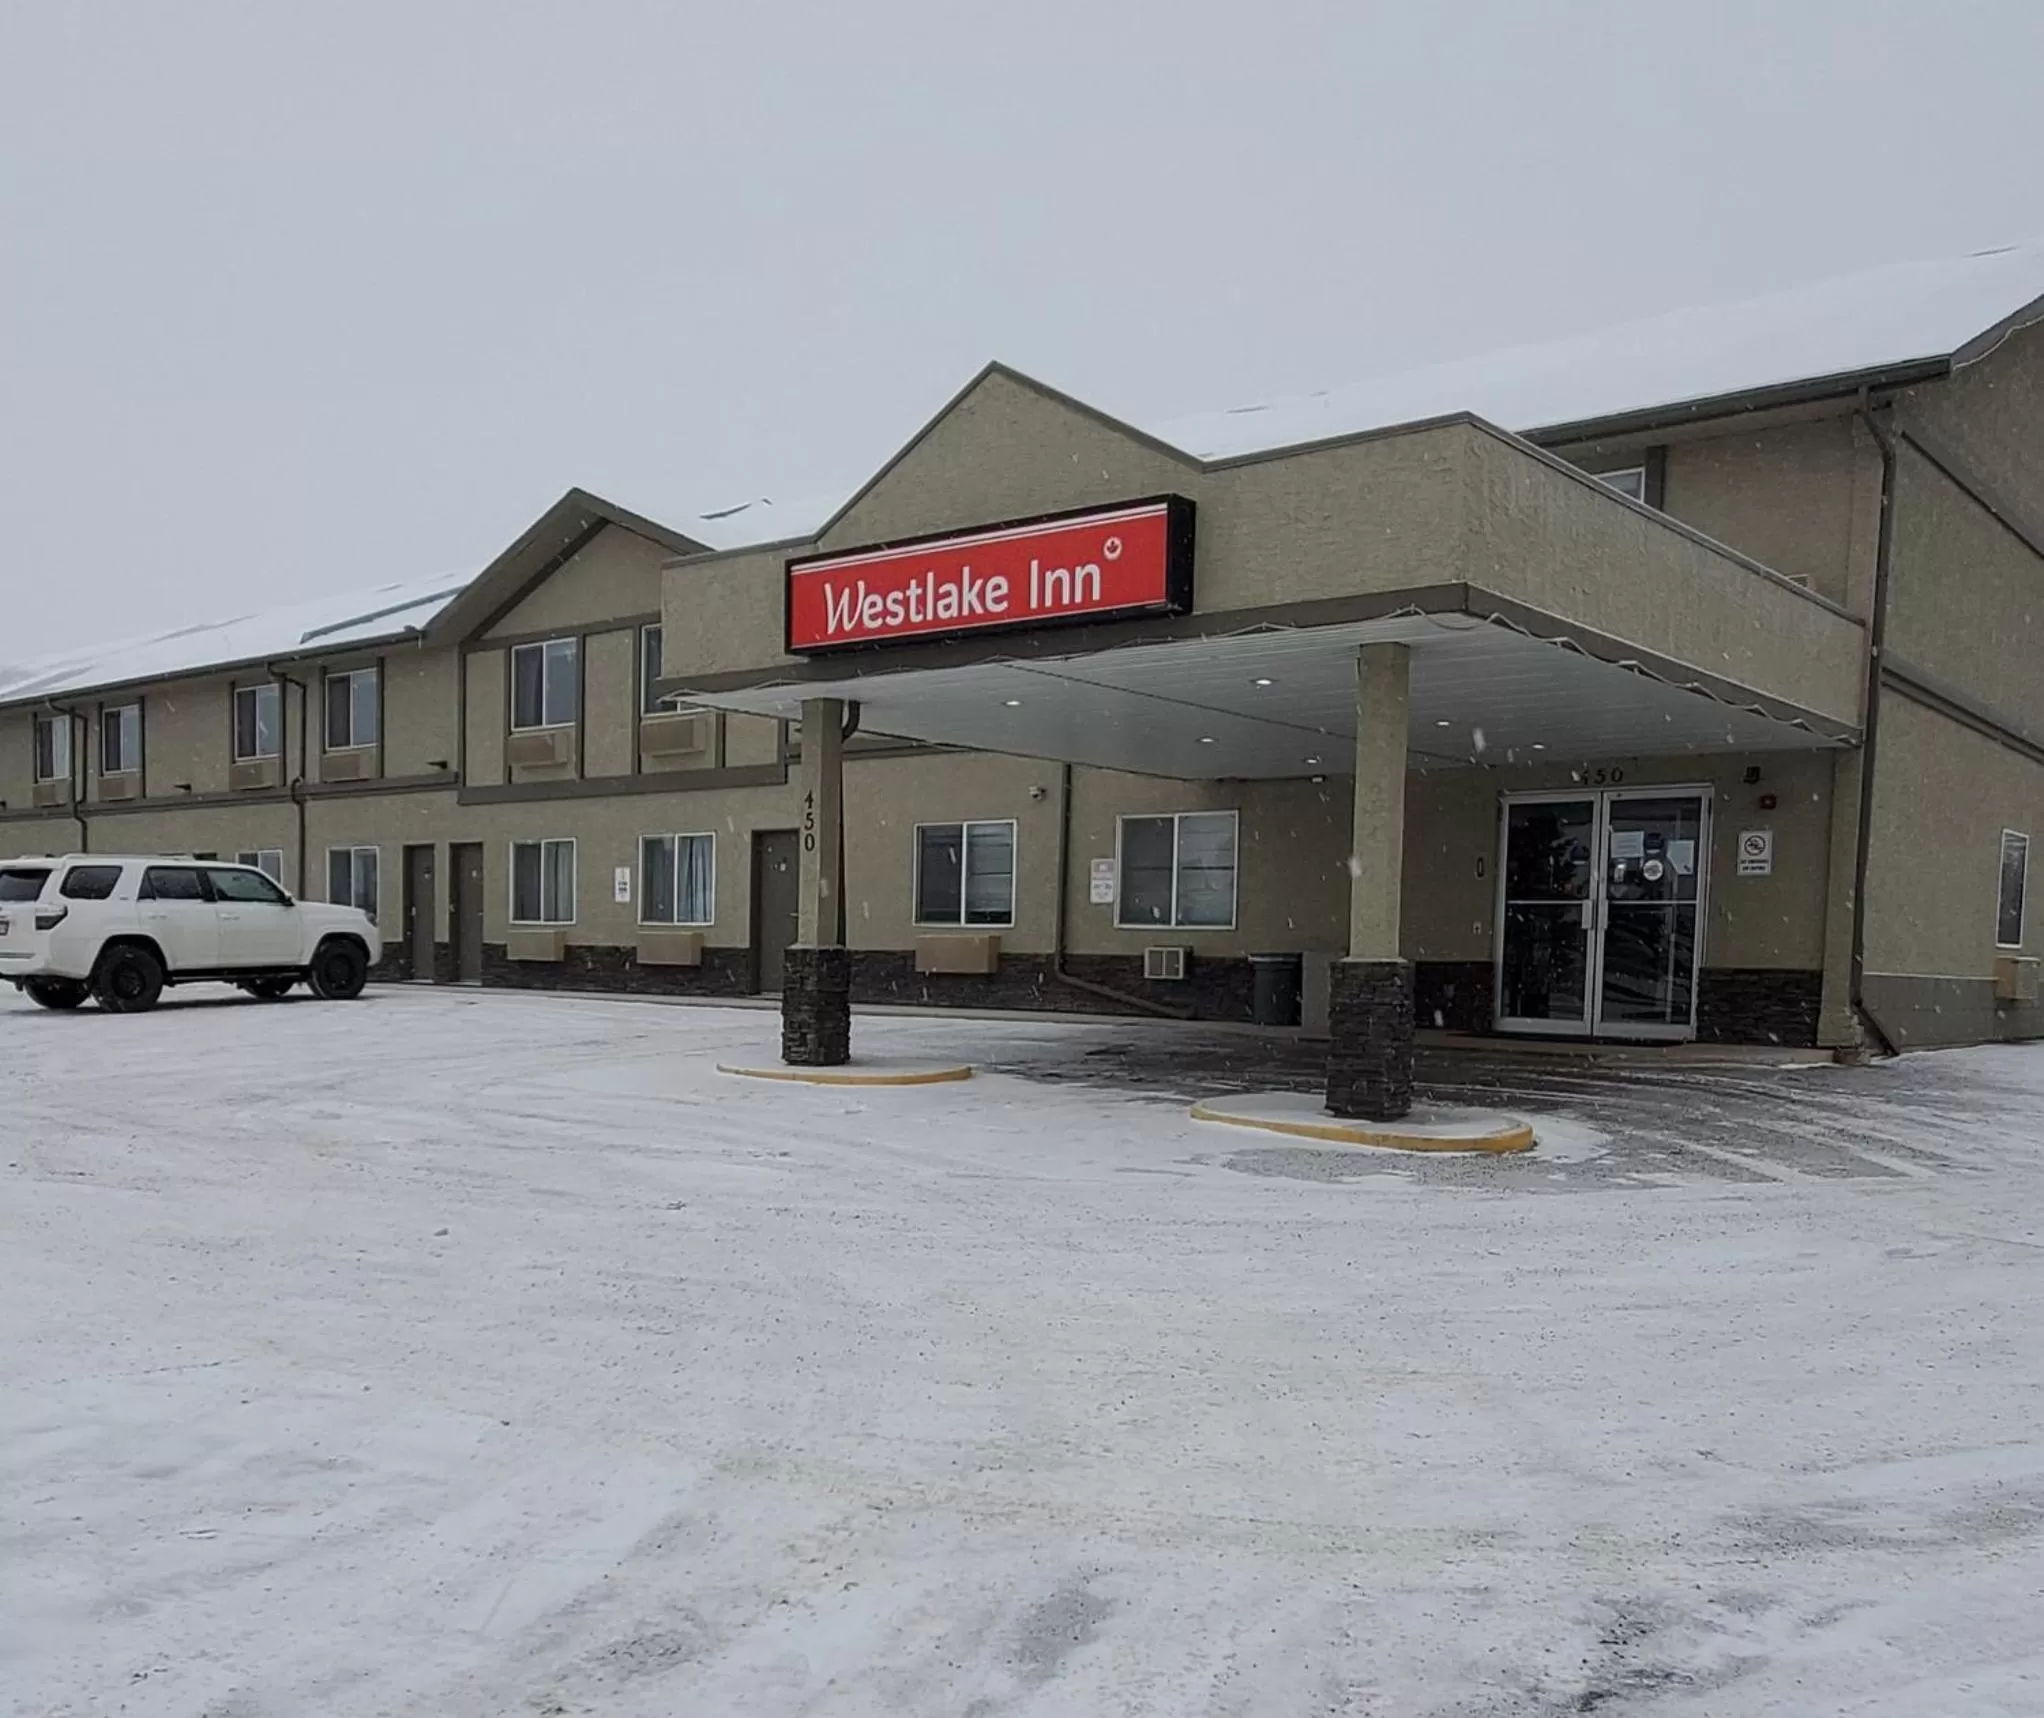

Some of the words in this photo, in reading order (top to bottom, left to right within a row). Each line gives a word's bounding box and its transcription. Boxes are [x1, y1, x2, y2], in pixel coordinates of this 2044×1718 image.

[823, 565, 1008, 634] Westlake
[1030, 558, 1102, 609] Inn
[804, 789, 815, 852] 450
